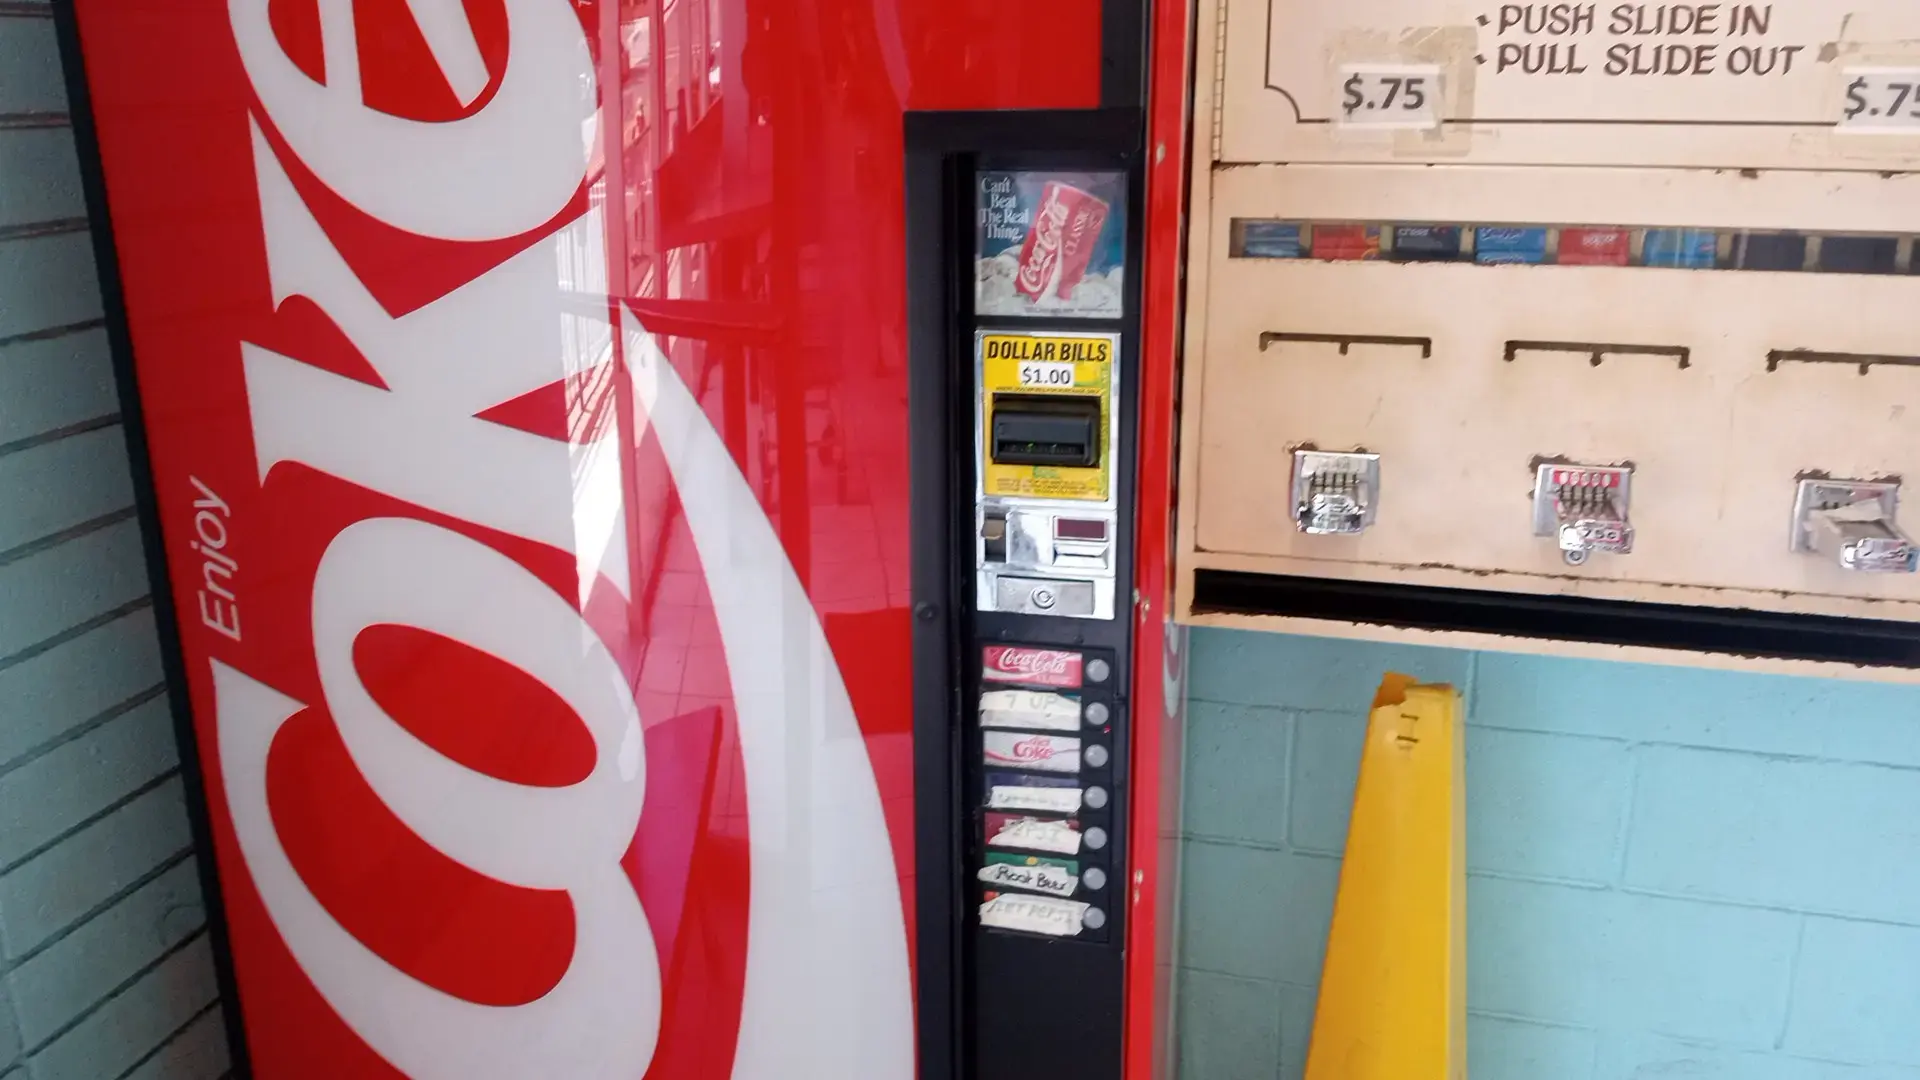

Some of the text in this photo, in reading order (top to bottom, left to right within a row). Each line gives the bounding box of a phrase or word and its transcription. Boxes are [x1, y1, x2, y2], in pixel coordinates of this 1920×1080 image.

[1498, 4, 1773, 36] PUSH SLIDE IN
[1496, 43, 1806, 76] PULL SLIDE OUT
[1341, 73, 1425, 115] $.75
[987, 340, 1108, 363] DOLLAR BILLS
[1022, 366, 1072, 386] $1.00
[212, 0, 662, 1080] Coke
[189, 475, 242, 642] Enjoy
[1005, 693, 1058, 710] 7 UP
